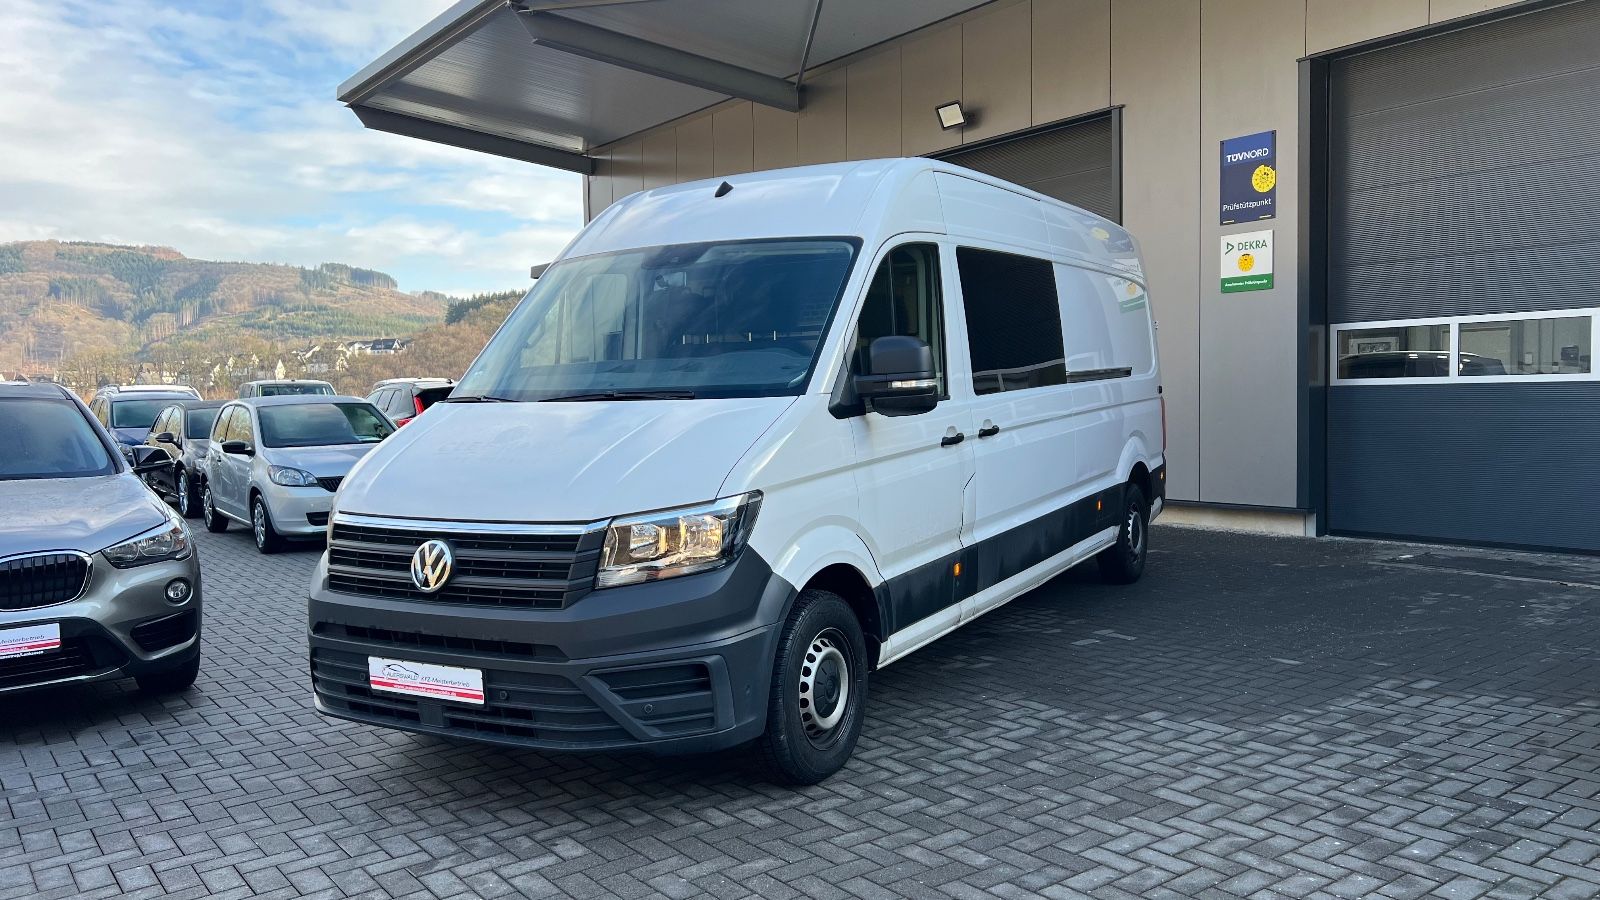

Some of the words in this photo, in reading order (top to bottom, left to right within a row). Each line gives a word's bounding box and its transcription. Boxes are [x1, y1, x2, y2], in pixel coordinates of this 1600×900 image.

[1222, 198, 1272, 212] Prüfstützpunkt
[1237, 240, 1268, 251] DEKRA
[411, 540, 452, 592] VW
[386, 671, 418, 681] AUERSWALD
